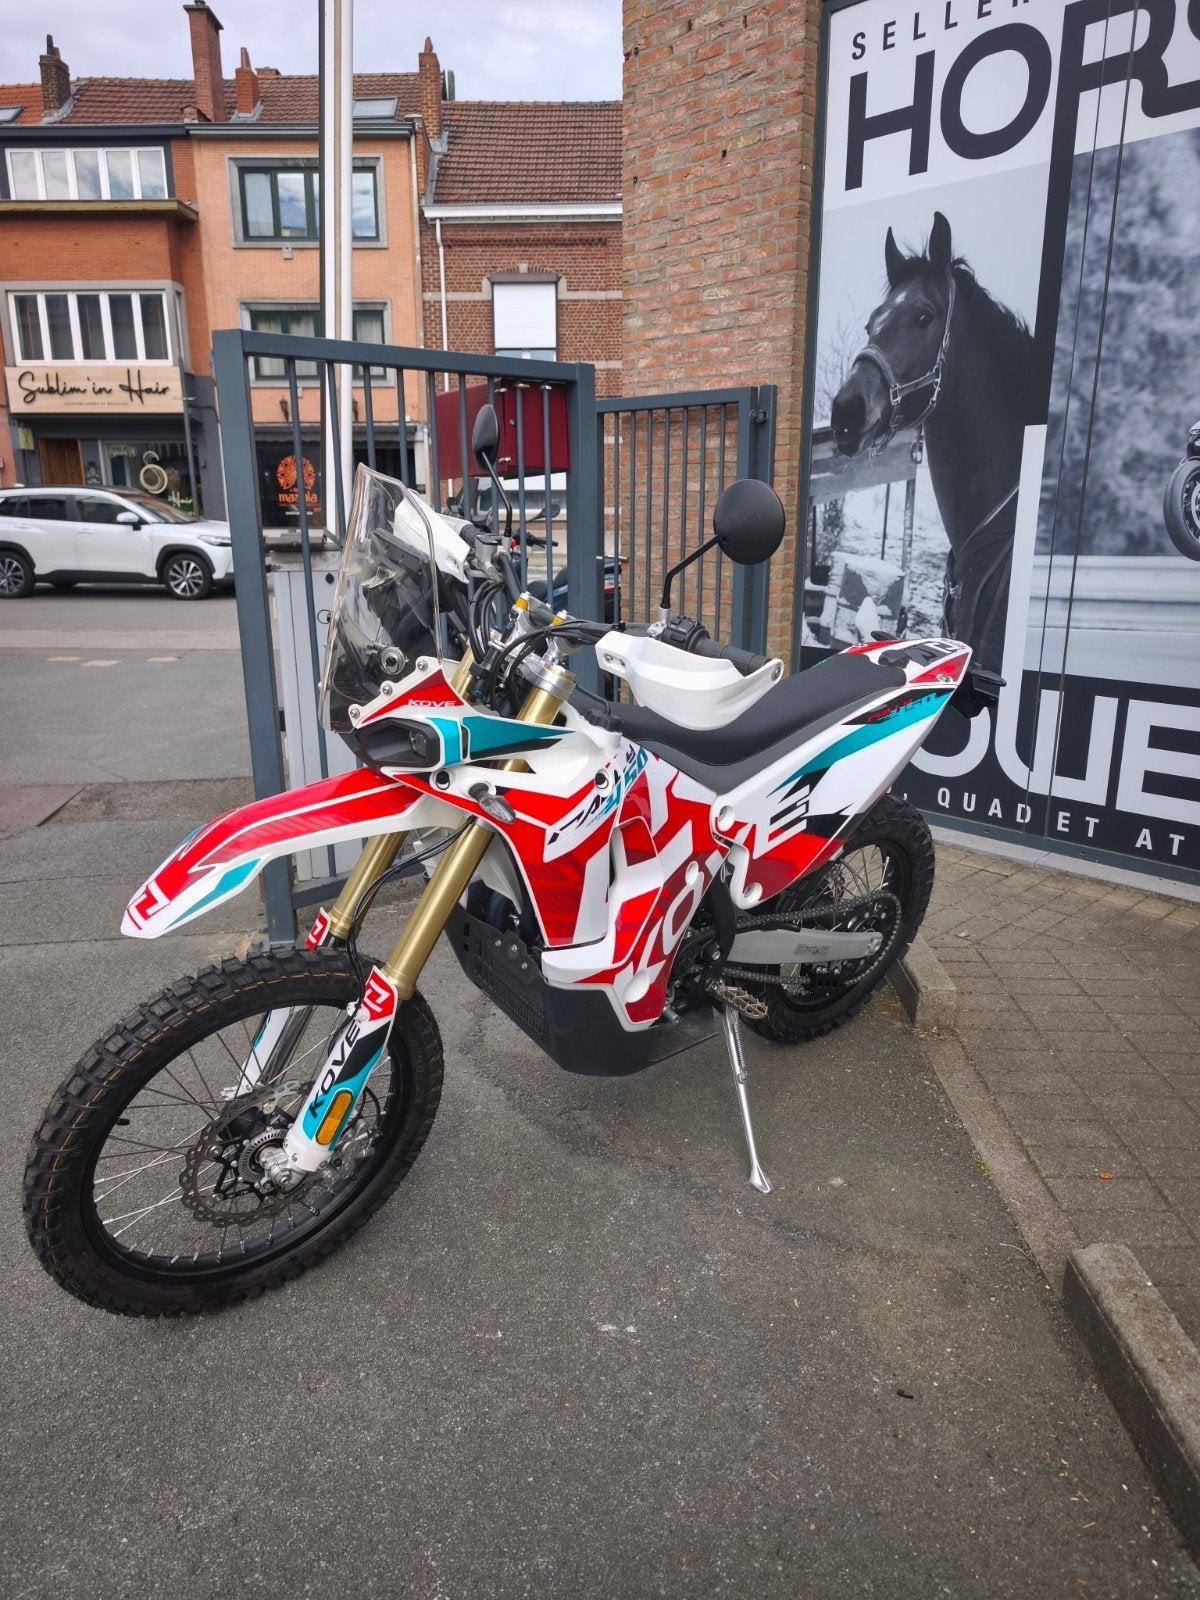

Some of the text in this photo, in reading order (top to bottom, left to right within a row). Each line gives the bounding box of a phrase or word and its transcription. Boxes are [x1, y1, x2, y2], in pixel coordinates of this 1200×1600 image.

[119, 369, 170, 404] Hair
[407, 699, 457, 707] KOVE
[937, 787, 1032, 823] QUAD
[1057, 812, 1099, 837] ET
[308, 1019, 361, 1118] KOVE
